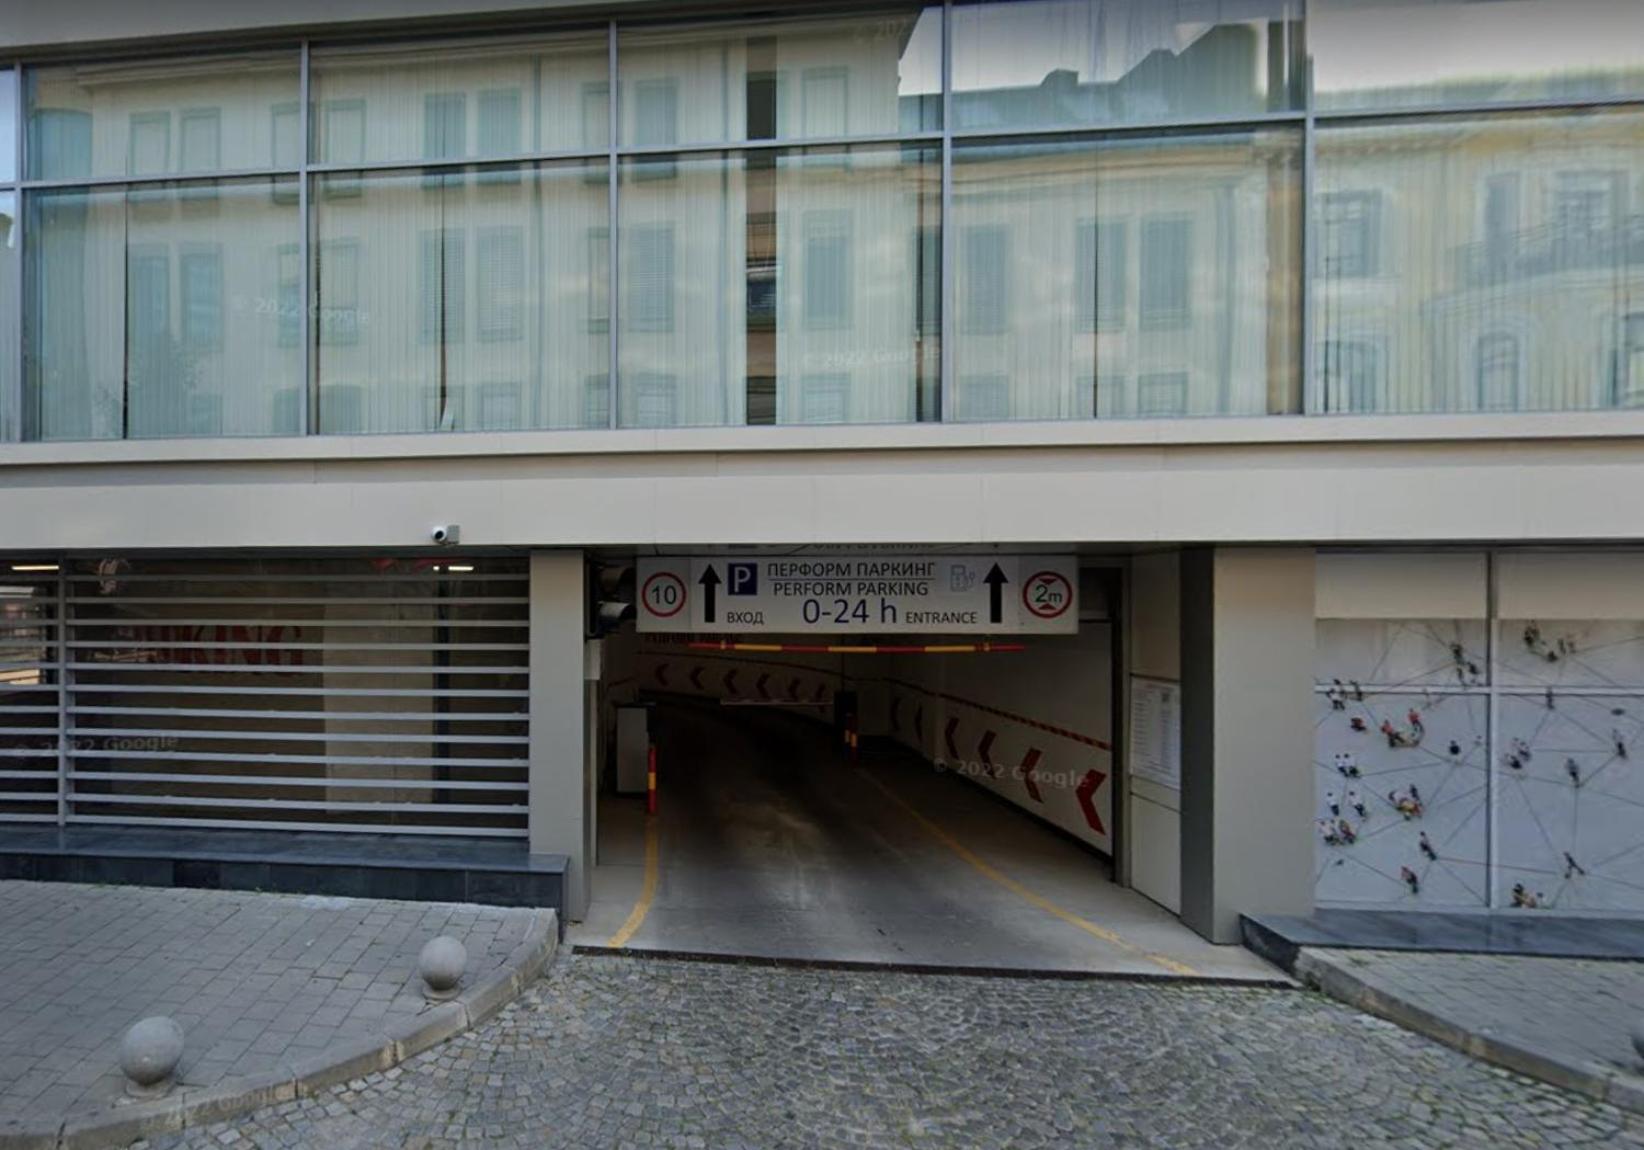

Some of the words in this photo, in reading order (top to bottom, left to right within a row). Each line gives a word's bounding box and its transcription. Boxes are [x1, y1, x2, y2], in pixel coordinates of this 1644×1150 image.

[767, 562, 850, 577] ПЕРФОРМ
[857, 562, 935, 577] ПАРКИНГ
[733, 566, 751, 593] P
[651, 585, 677, 605] 10
[774, 582, 851, 596] PERFORM
[857, 581, 928, 596] PARKING
[1035, 584, 1062, 603] 2m
[727, 612, 764, 625] ВХОД
[803, 598, 869, 624] 0-24
[881, 597, 897, 624] h
[906, 612, 977, 624] ENTRANCE
